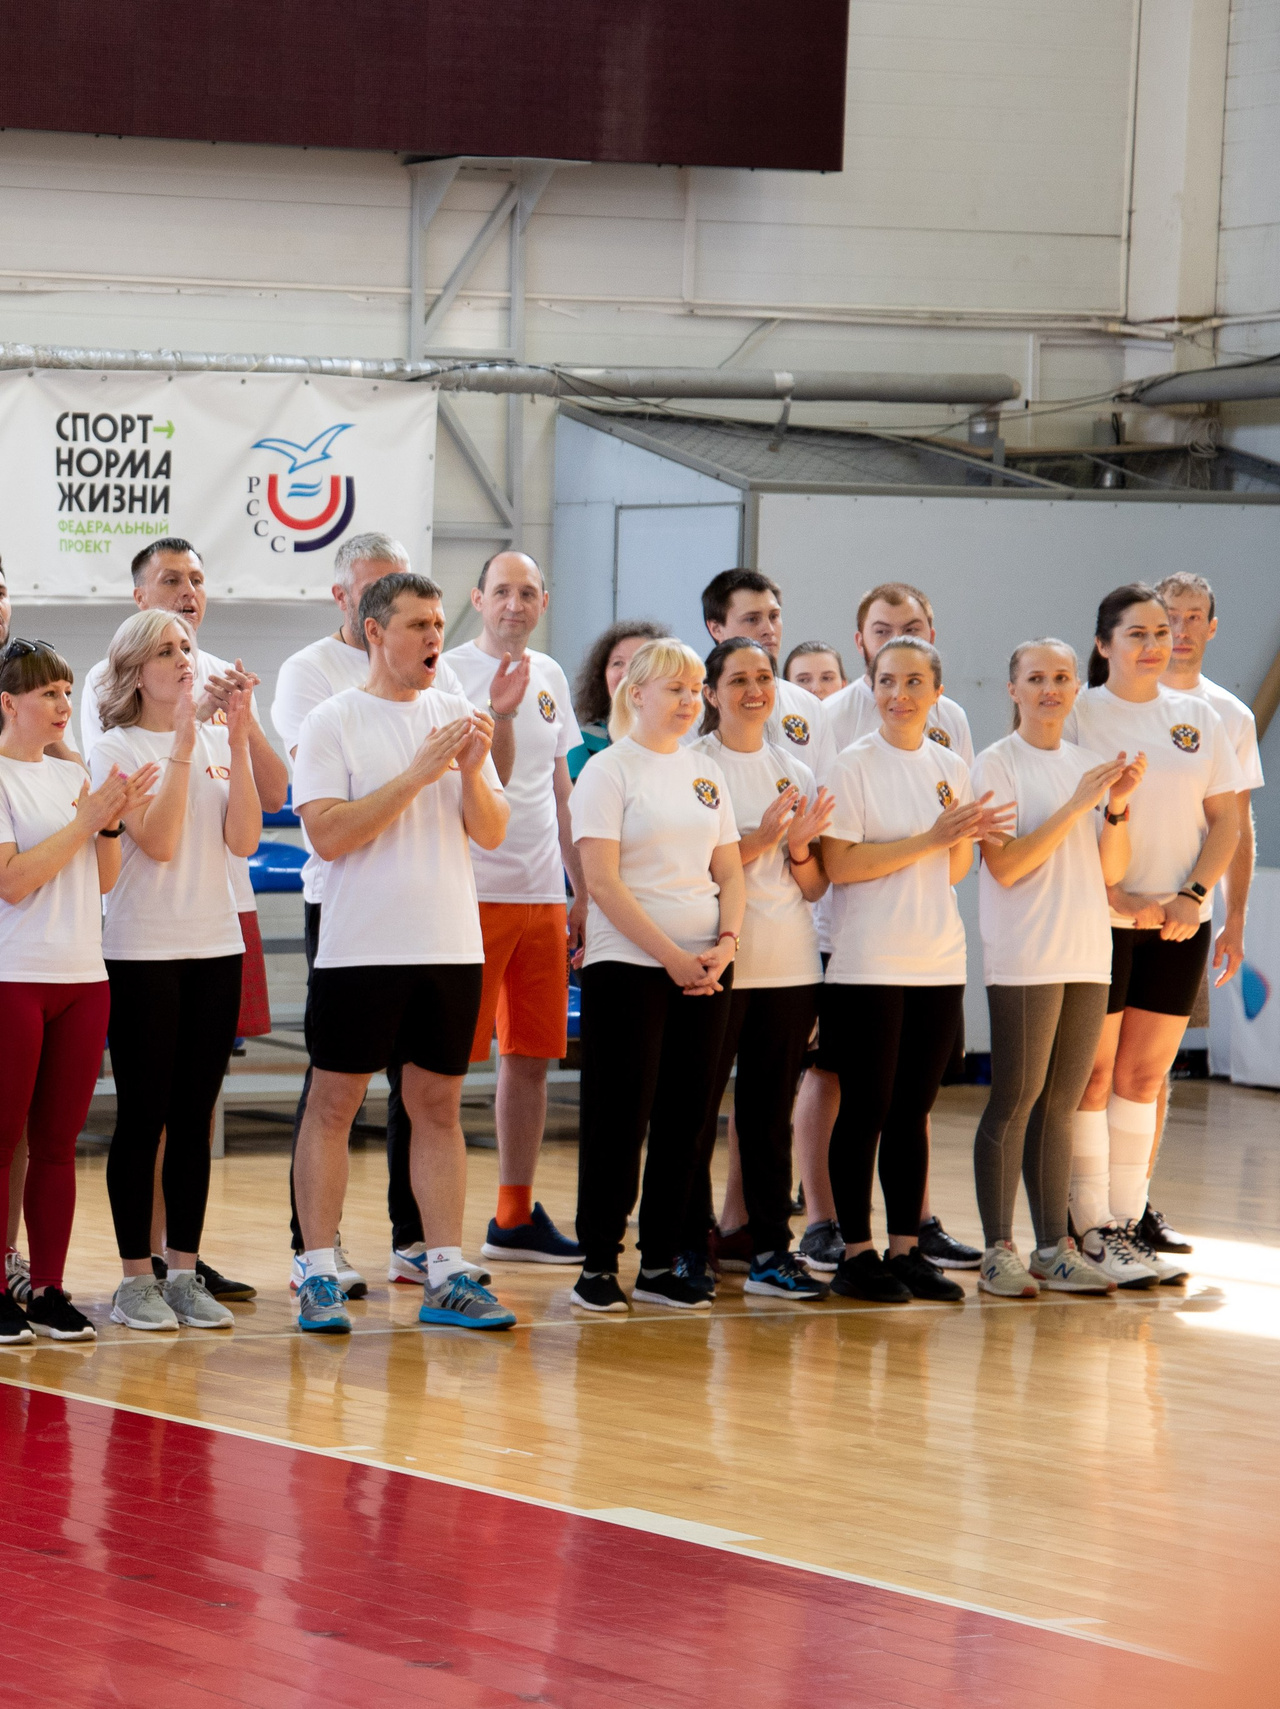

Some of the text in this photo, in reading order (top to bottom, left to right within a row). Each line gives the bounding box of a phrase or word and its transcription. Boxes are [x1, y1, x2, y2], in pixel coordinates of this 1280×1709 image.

[56, 411, 153, 444] СПОРТ
[56, 446, 172, 480] НОРМА
[57, 481, 170, 515] ЖИЗНИ
[58, 518, 169, 536] ФЕДЕРАЛЬНЫЙ
[59, 539, 111, 554] ПРОЕКТ
